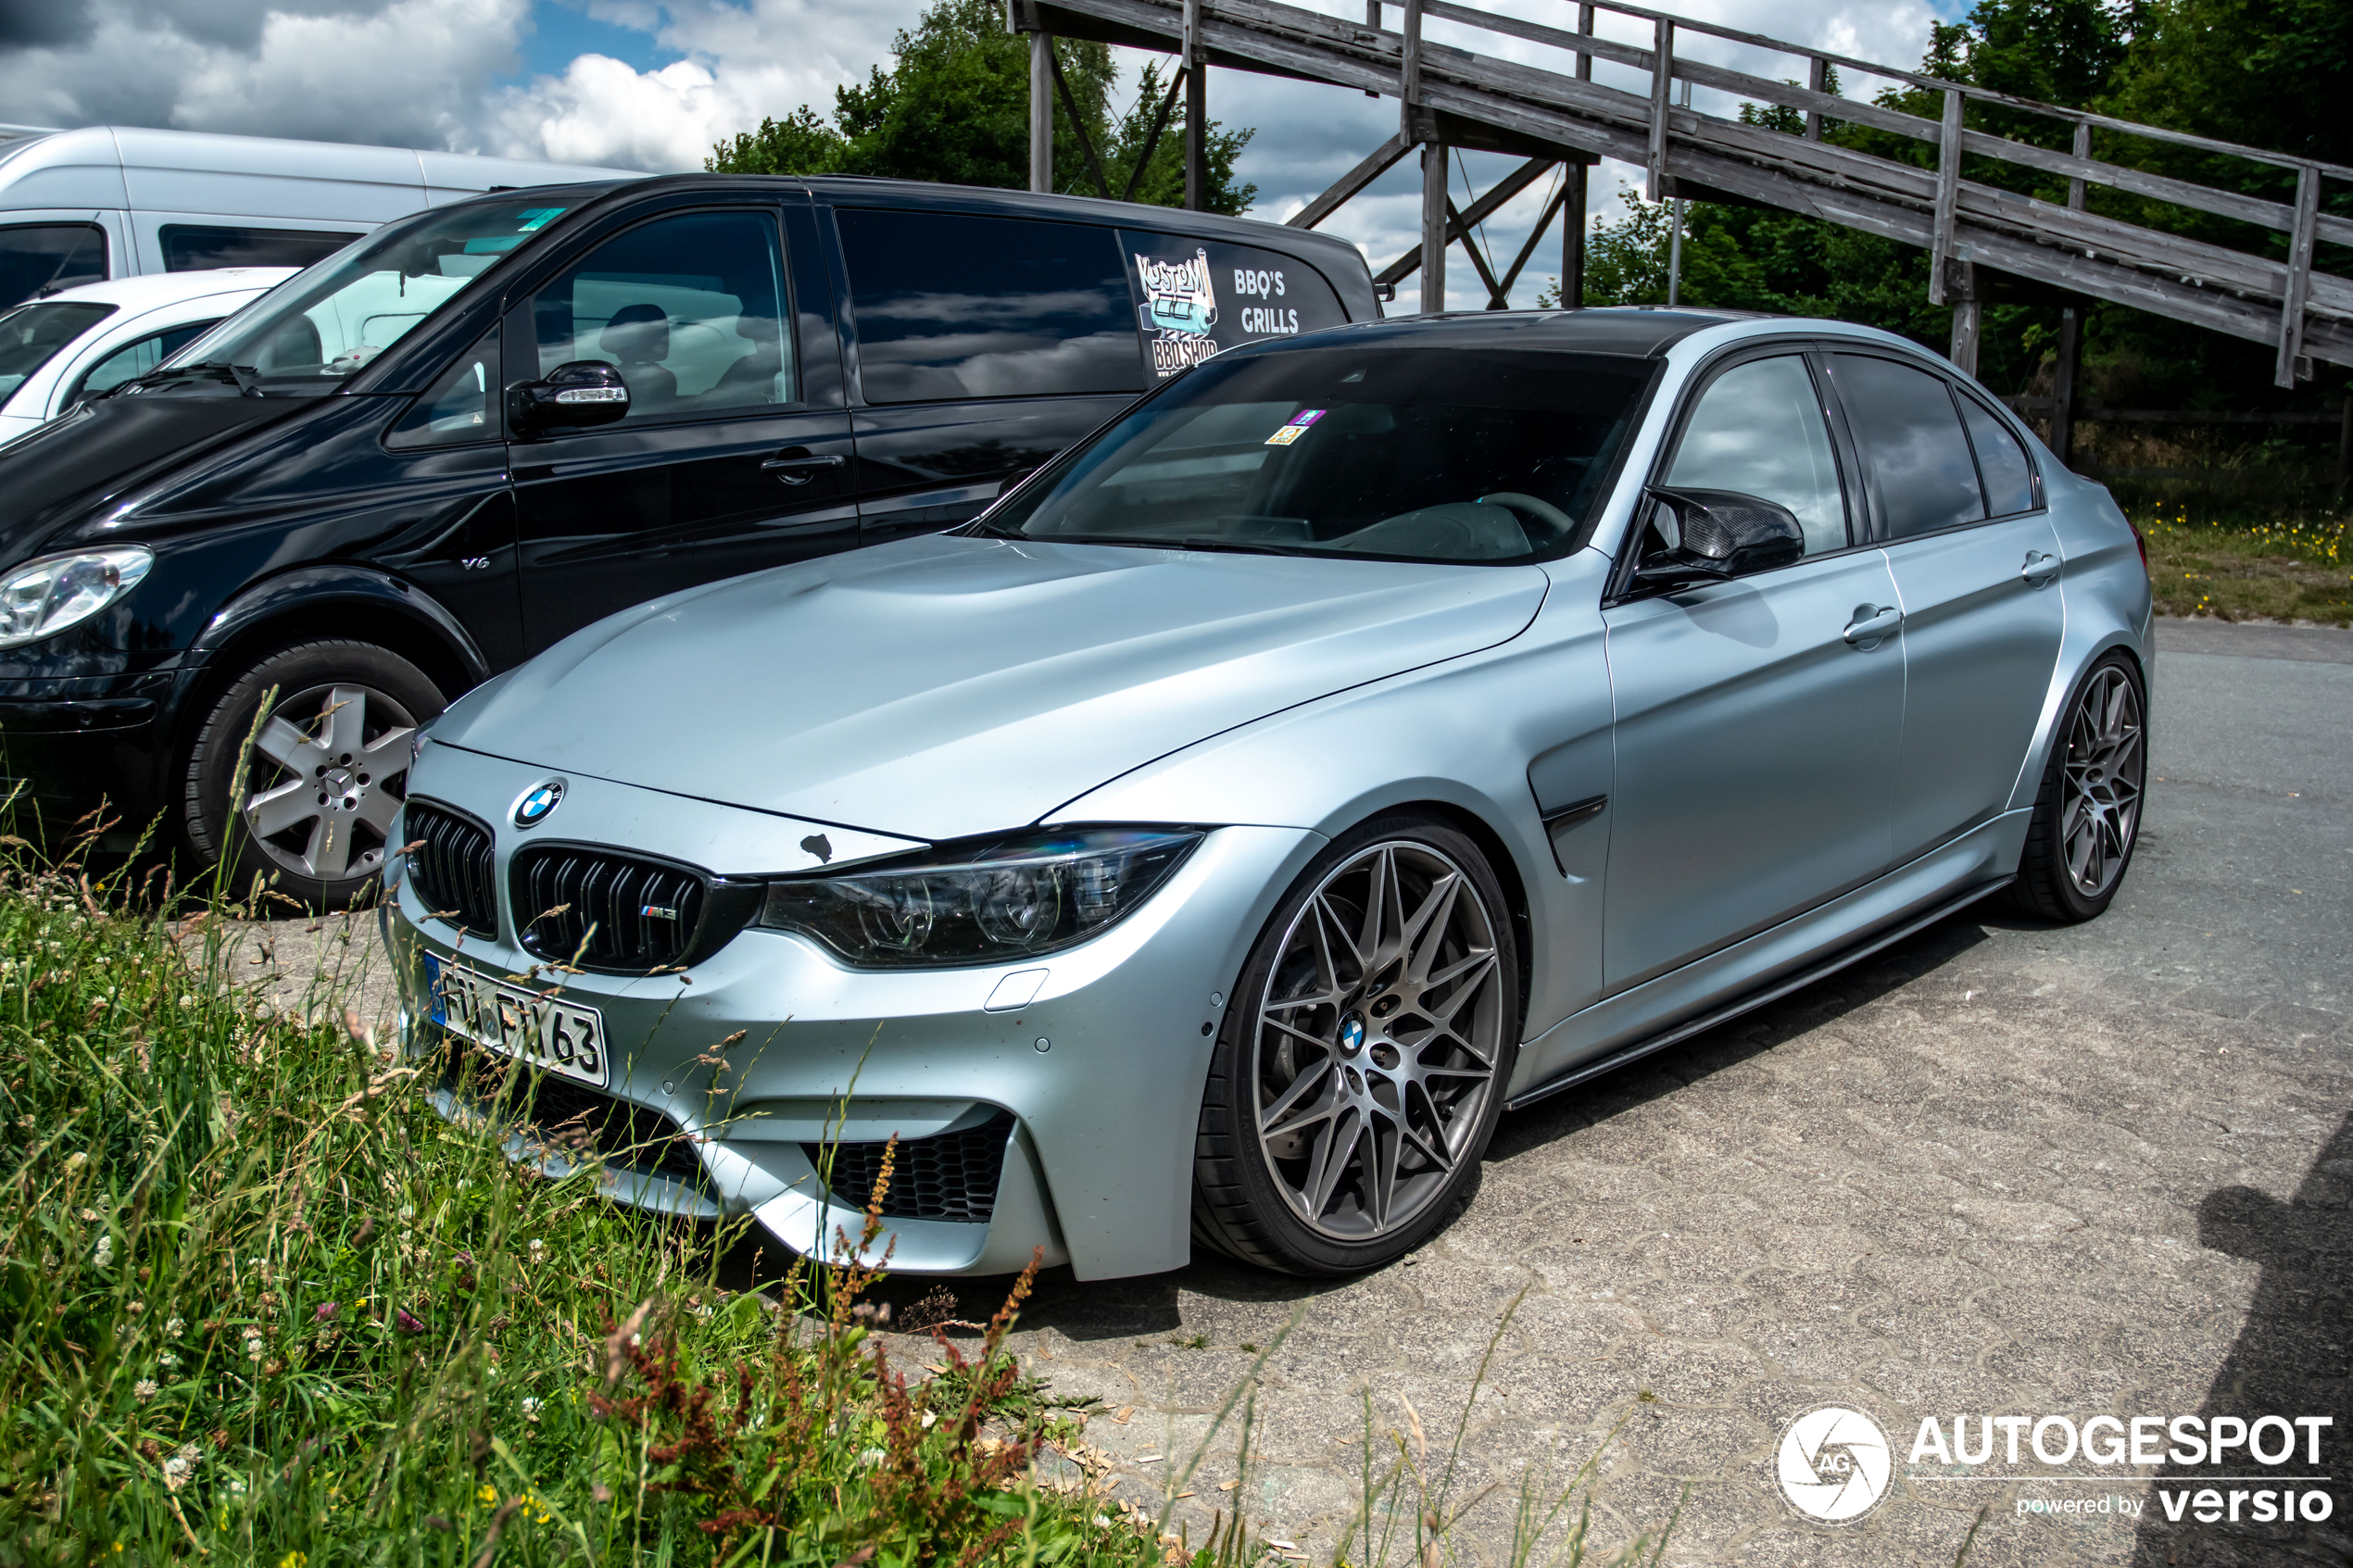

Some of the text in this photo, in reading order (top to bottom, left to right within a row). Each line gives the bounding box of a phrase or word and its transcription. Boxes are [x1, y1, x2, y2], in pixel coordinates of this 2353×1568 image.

[1135, 254, 1206, 296] KUSTOM
[1234, 269, 1286, 299] BBQ'S
[1241, 307, 1299, 334] GRILLS
[461, 557, 491, 571] V6
[650, 907, 677, 921] M3
[552, 1010, 599, 1074] 63
